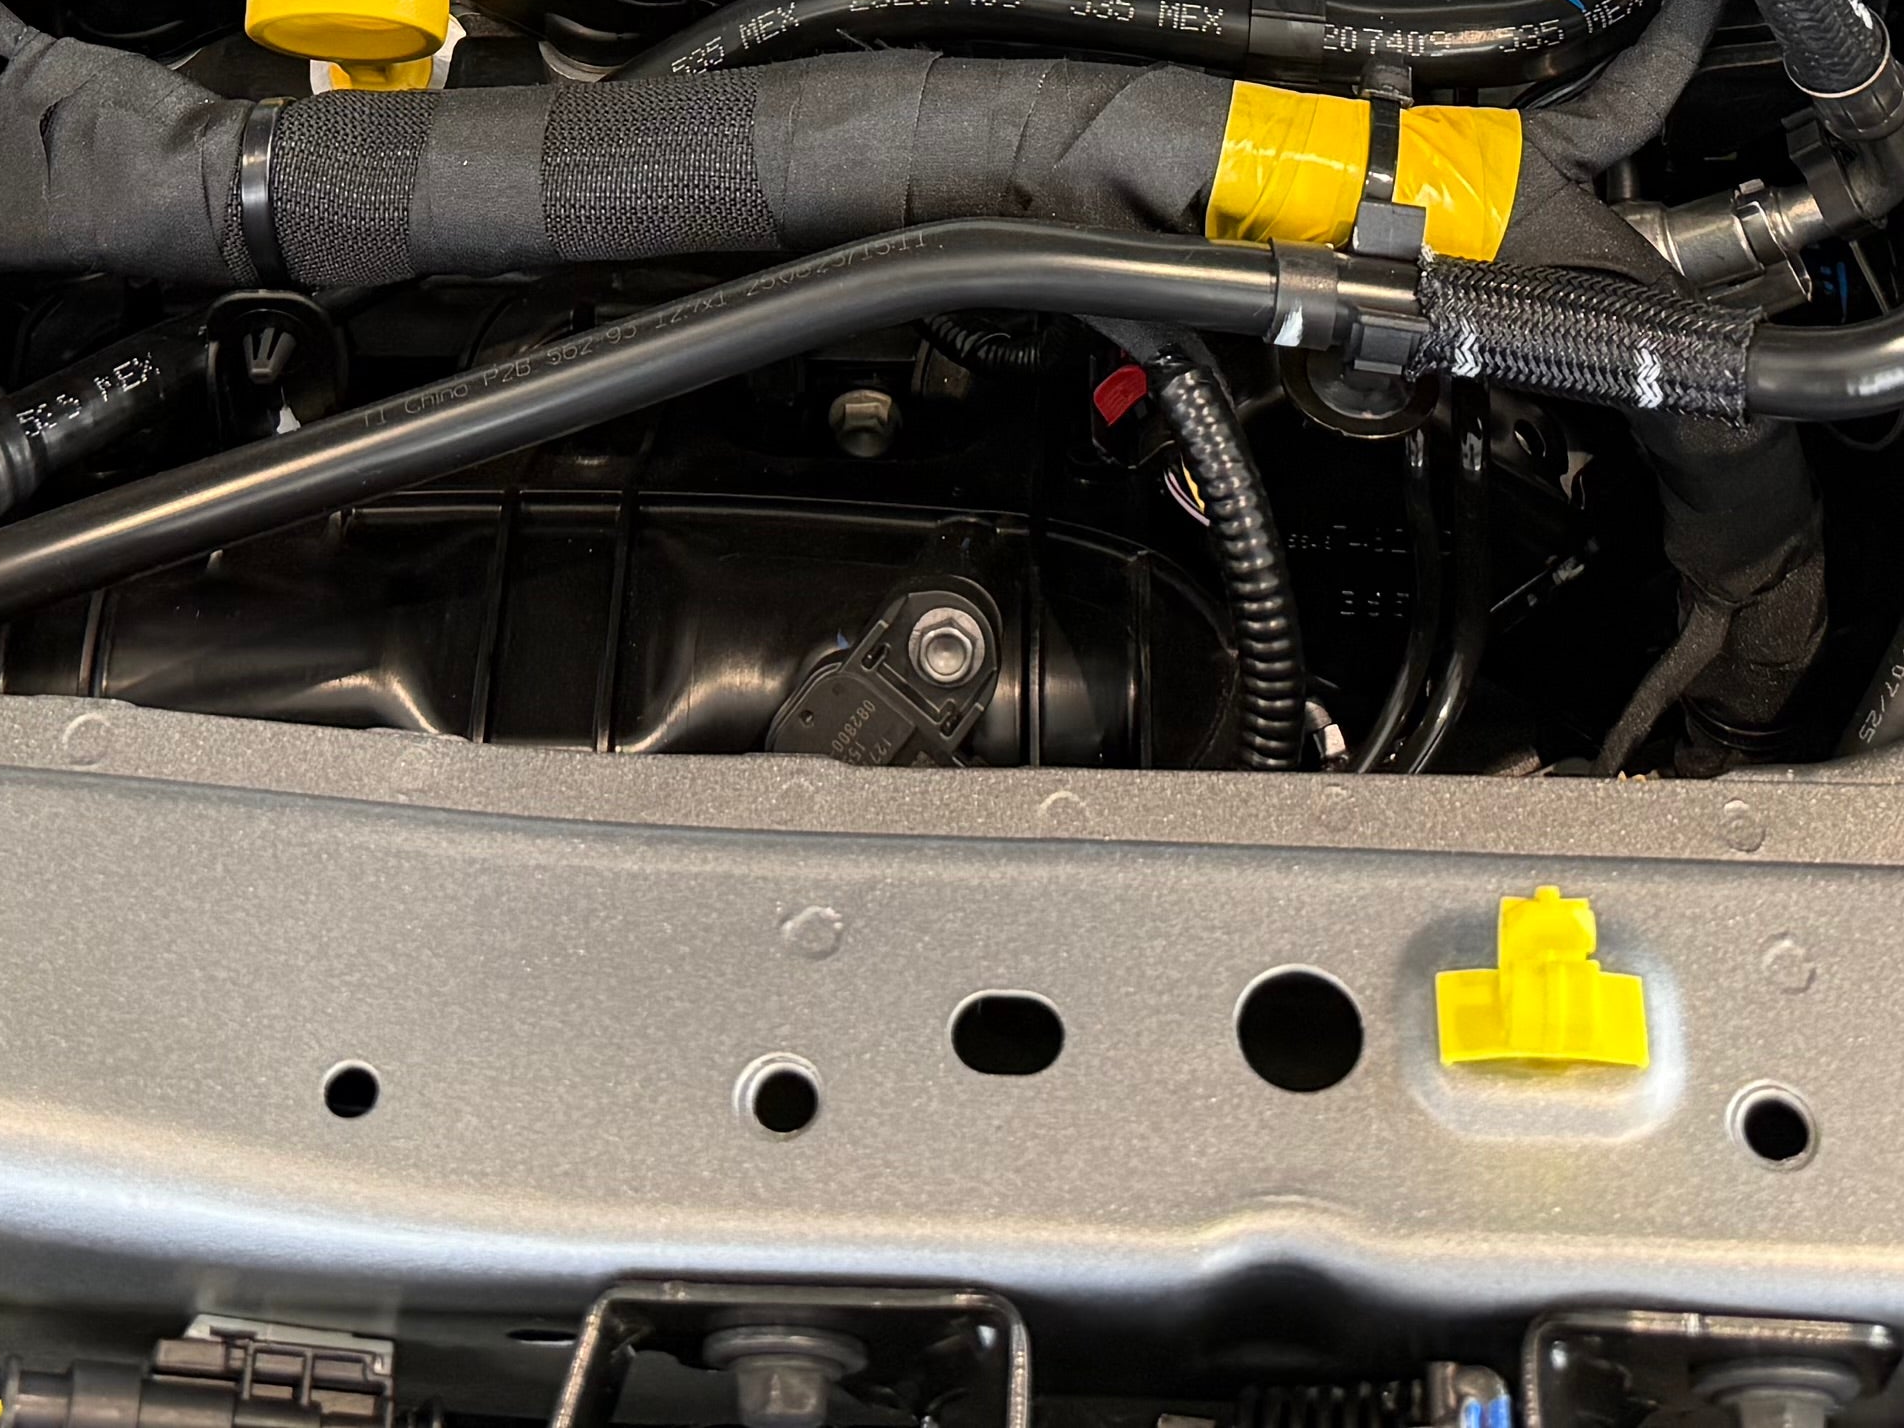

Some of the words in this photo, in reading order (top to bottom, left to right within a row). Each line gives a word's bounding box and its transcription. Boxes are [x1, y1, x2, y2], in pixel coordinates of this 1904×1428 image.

[738, 1, 798, 50] MEX
[1157, 0, 1224, 35] MEX
[483, 359, 533, 387] P2B
[831, 699, 876, 753] 082800
